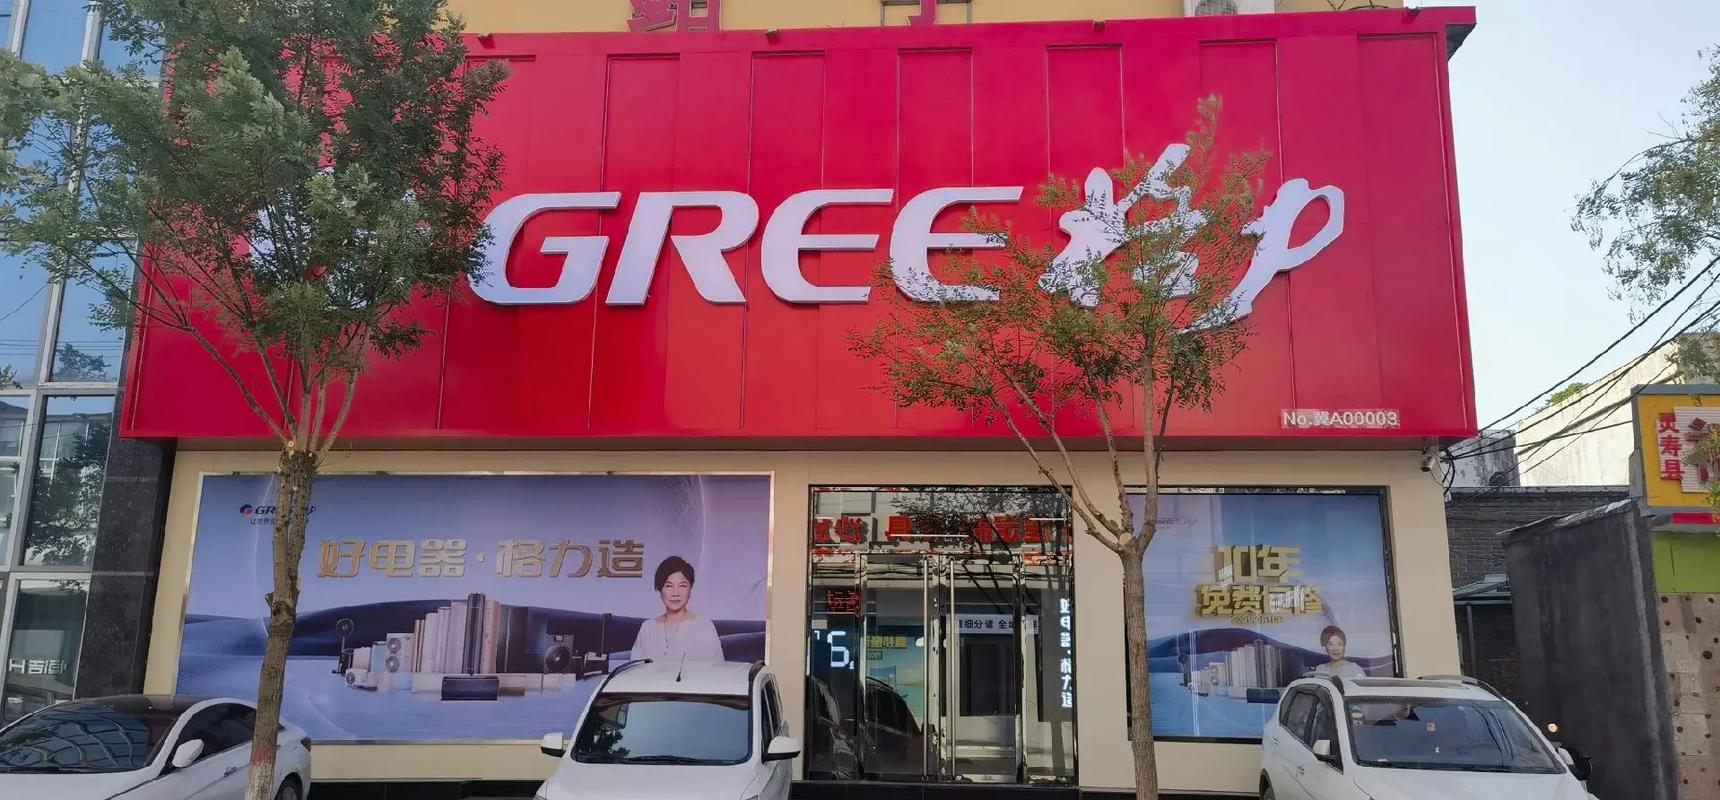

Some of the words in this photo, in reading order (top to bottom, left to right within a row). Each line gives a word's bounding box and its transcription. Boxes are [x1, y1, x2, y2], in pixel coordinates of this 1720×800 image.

[470, 186, 1024, 305] GREE
[1658, 413, 1685, 480] 灵寿县
[316, 538, 646, 578] 好电器·格力造
